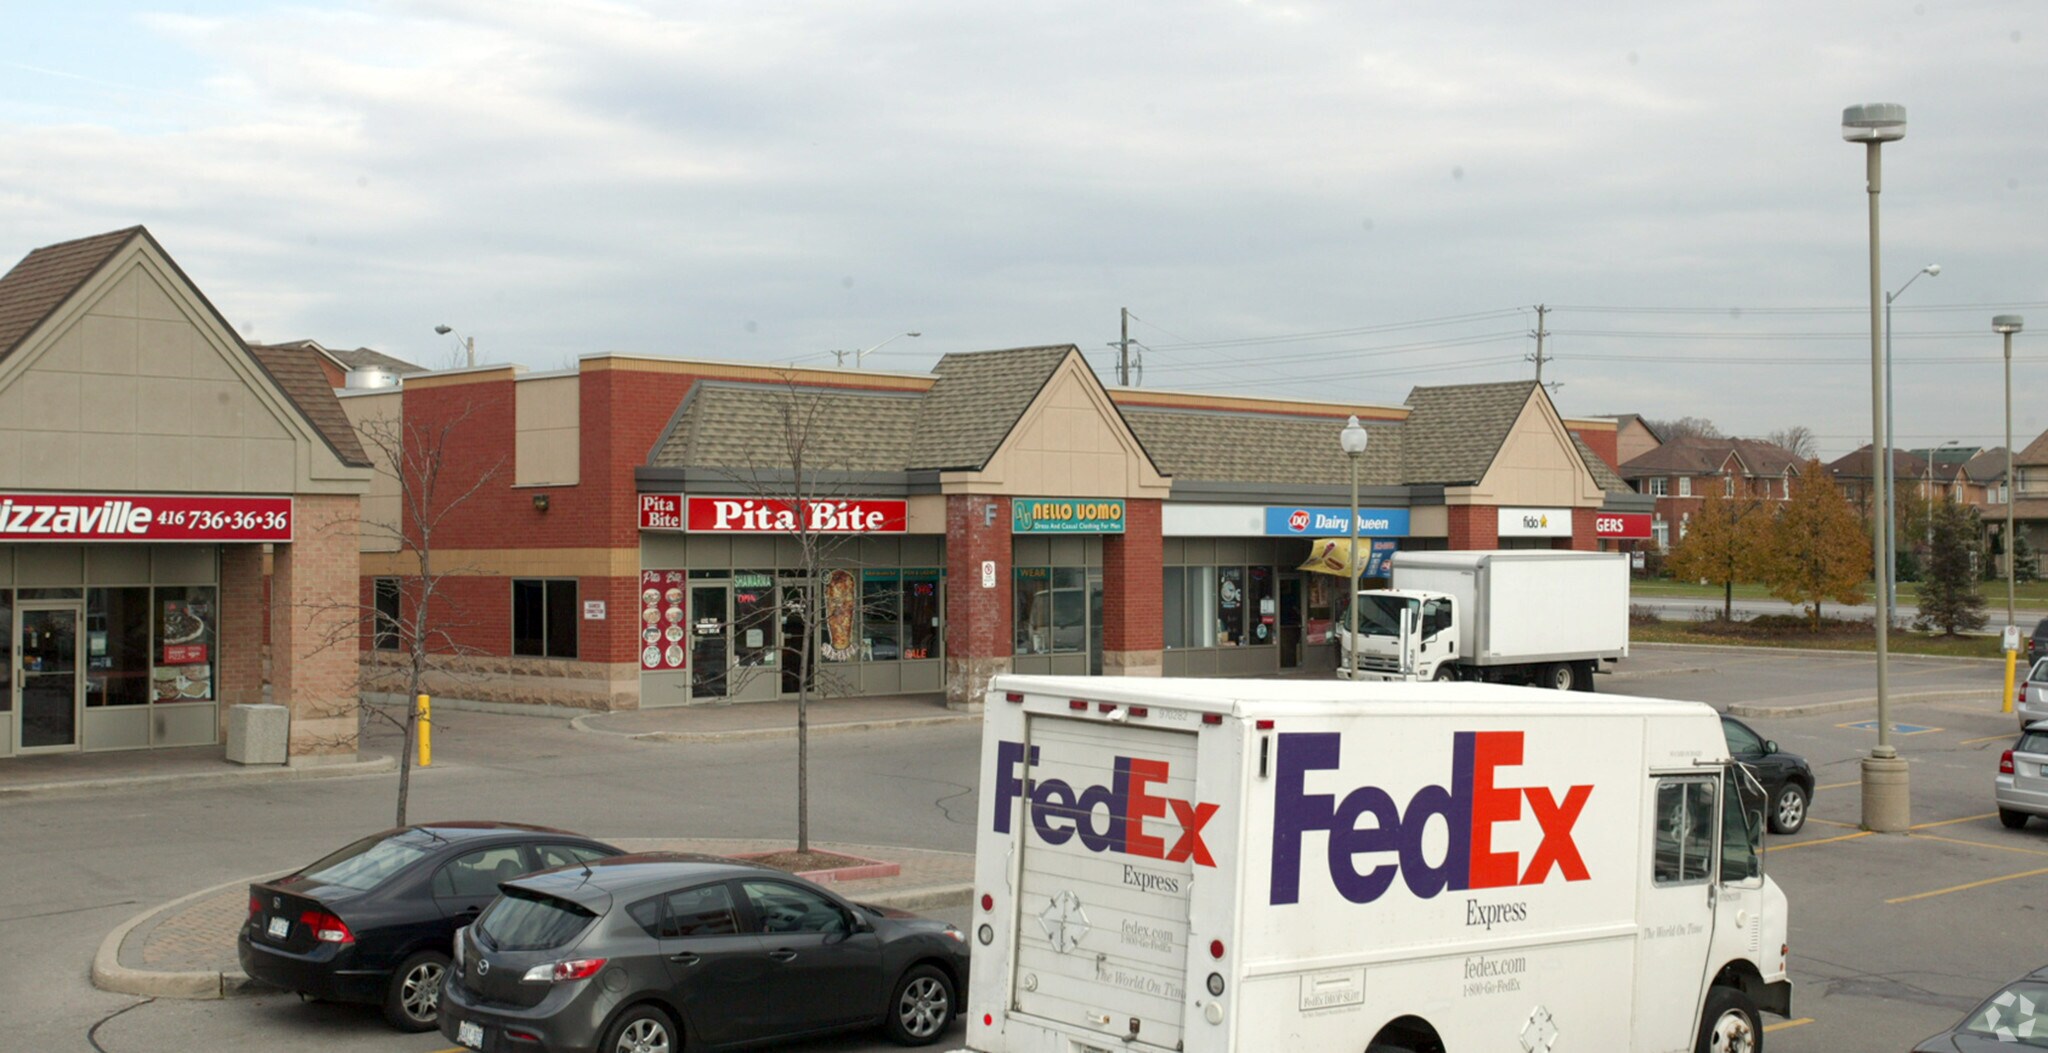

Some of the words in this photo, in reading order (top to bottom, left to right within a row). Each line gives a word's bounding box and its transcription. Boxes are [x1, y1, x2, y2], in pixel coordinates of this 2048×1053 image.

[643, 497, 674, 512] Pita
[985, 504, 998, 526] F
[1033, 503, 1073, 520] NELLO
[1076, 503, 1121, 520] UOMO
[0, 500, 152, 533] izzaville
[157, 510, 185, 525] 416
[649, 512, 679, 527] Bite
[713, 500, 796, 530] Pita
[809, 502, 884, 531] Bite
[1292, 515, 1306, 526] DQ
[1315, 514, 1349, 533] Dairy
[1523, 516, 1539, 528] fido
[1079, 523, 1100, 531] Clothing
[1021, 569, 1046, 577] WEAR
[993, 740, 1221, 868] FedEx
[1270, 731, 1595, 905] FedEx
[1123, 864, 1179, 893] Express
[1466, 899, 1527, 930] Express
[1121, 919, 1173, 943] fedex.com
[1656, 926, 1675, 938] World
[1464, 957, 1526, 979] fedex.com
[1114, 972, 1146, 989] World
[1147, 978, 1162, 993] On
